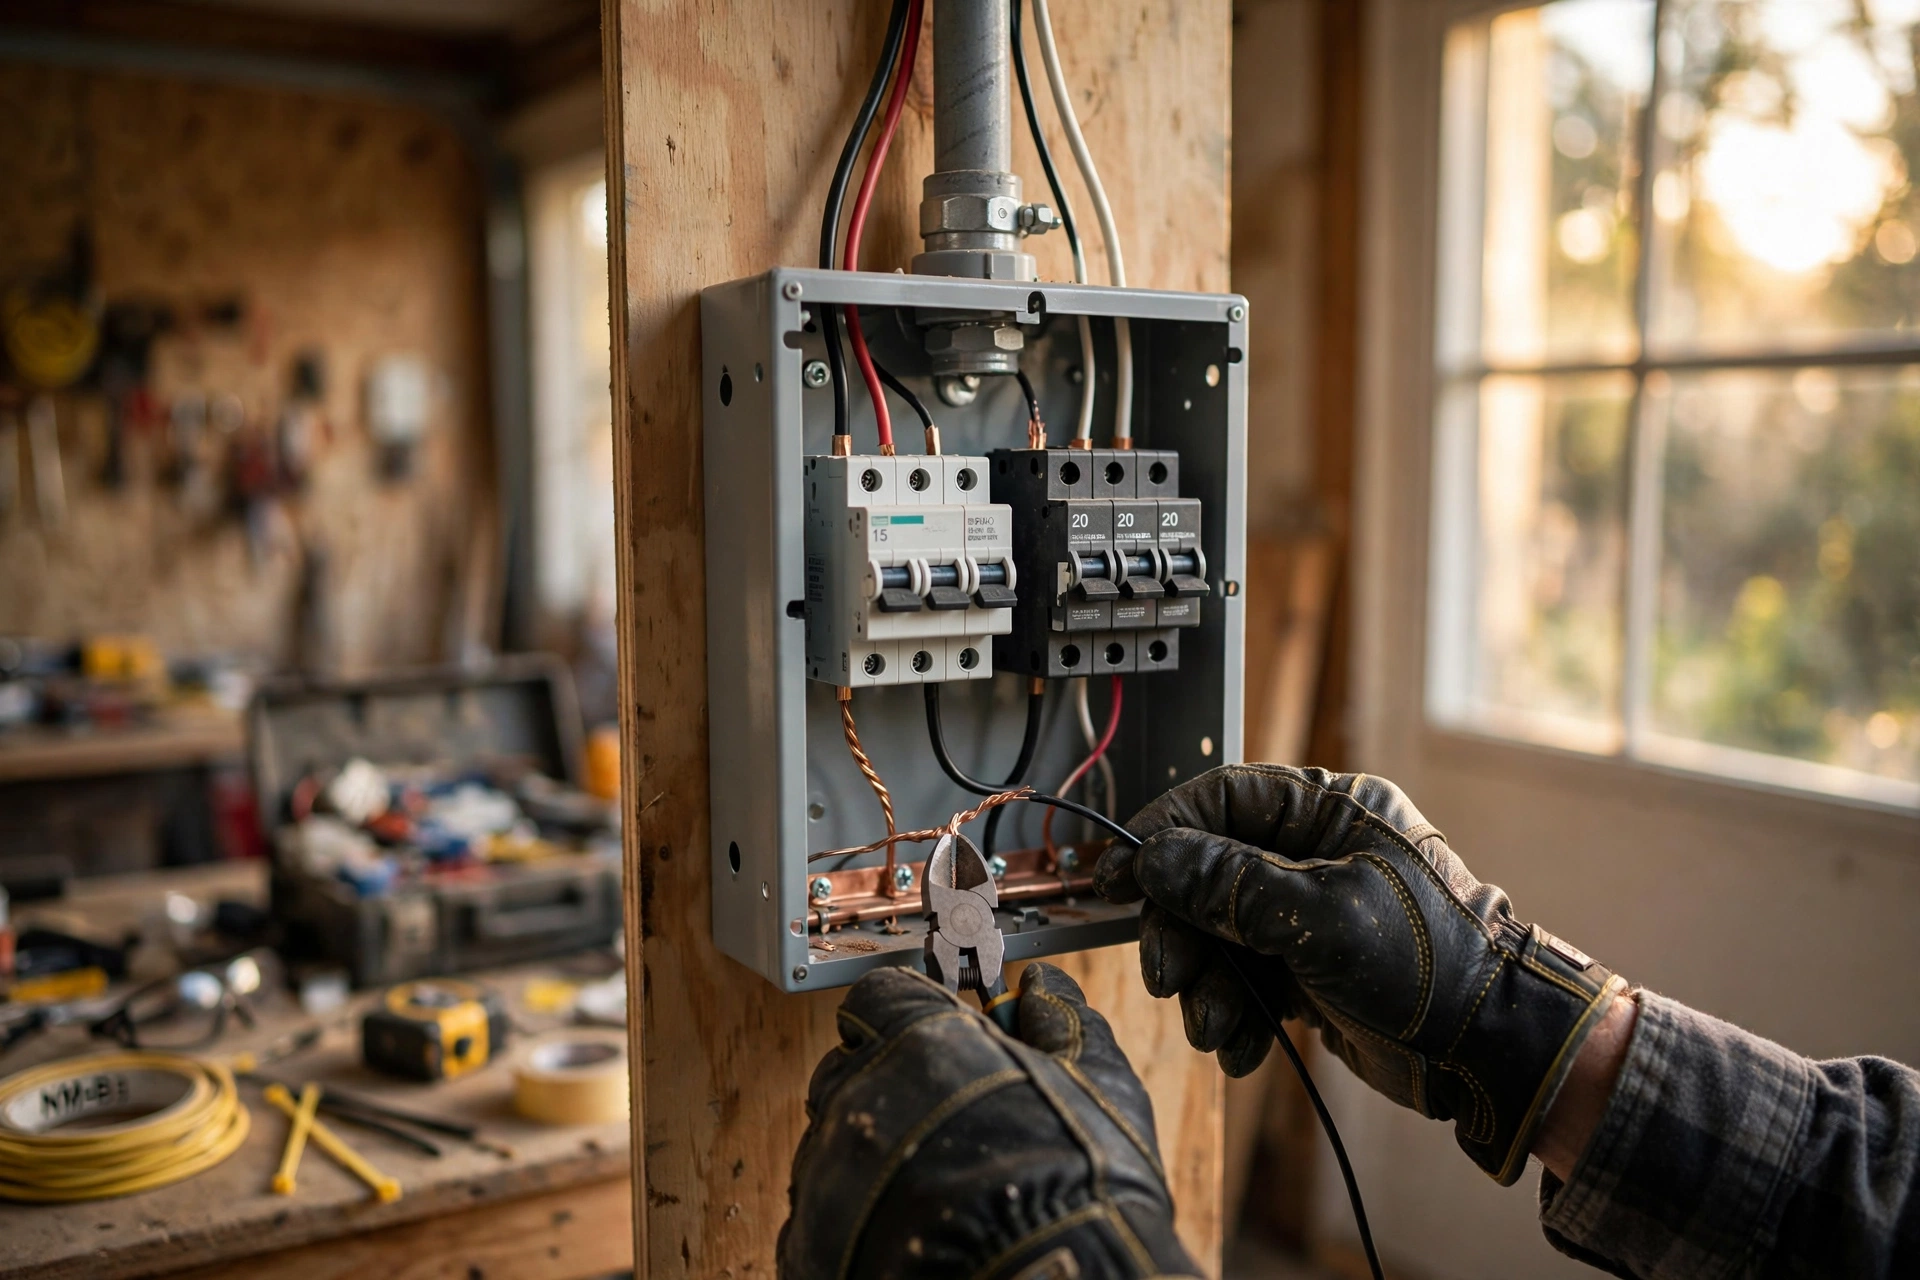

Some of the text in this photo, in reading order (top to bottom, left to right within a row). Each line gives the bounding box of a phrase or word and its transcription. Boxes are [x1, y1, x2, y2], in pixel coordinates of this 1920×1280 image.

[1072, 513, 1089, 528] 20
[1117, 513, 1134, 527] 20
[1161, 512, 1178, 527] 20
[872, 528, 888, 542] 15
